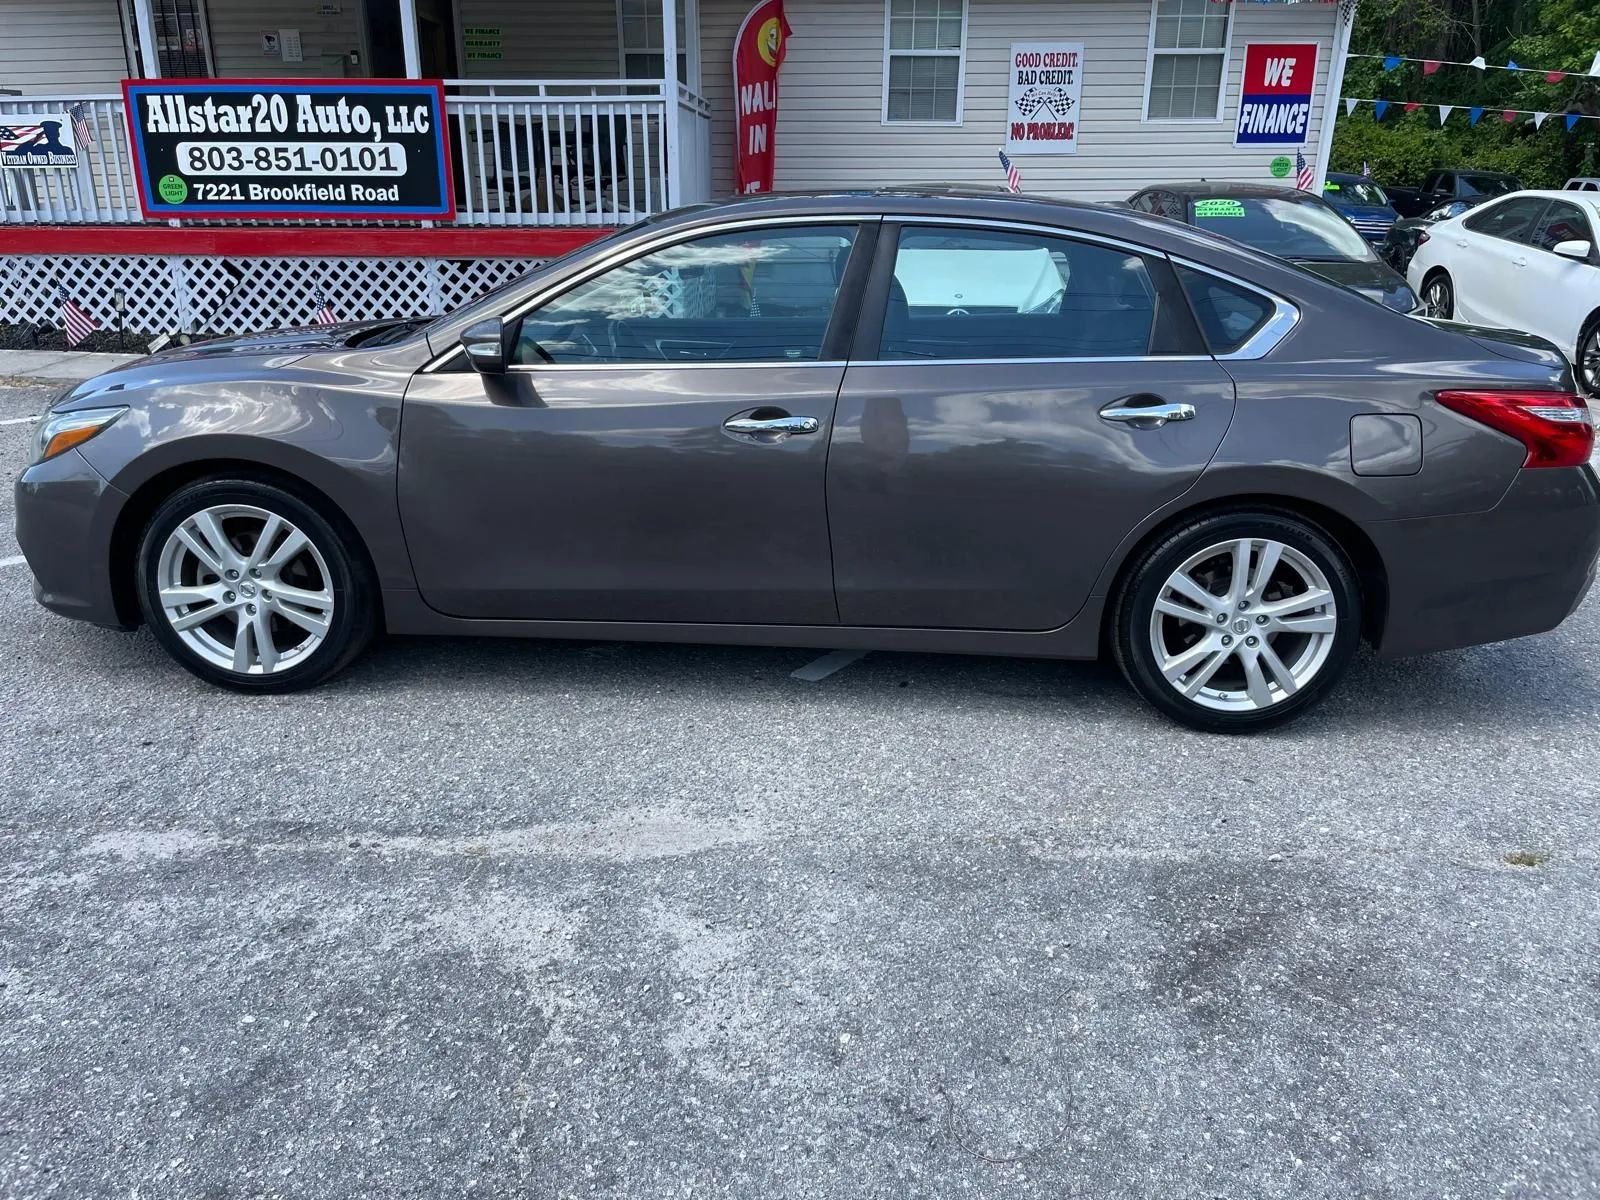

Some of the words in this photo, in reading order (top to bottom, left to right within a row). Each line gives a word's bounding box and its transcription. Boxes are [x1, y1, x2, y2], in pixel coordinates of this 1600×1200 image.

[1015, 53, 1041, 68] GOOD
[1043, 53, 1078, 67] CREDIT.
[1264, 57, 1297, 87] WE
[1018, 70, 1037, 84] BAD
[1039, 70, 1074, 85] CREDIT.
[146, 92, 289, 134] Allstar20
[296, 92, 382, 143] Auto,
[387, 104, 430, 135] LLC
[1239, 103, 1309, 135] FINANCE
[749, 124, 767, 155] IN
[1011, 122, 1025, 140] NO
[1, 151, 27, 165] VETERAN
[27, 152, 48, 165] OWNED
[48, 151, 76, 165] BUSINESS
[188, 145, 398, 173] 803-851-0101
[193, 183, 246, 202] 7221
[249, 183, 347, 203] Brookfield
[350, 184, 399, 202] Road
